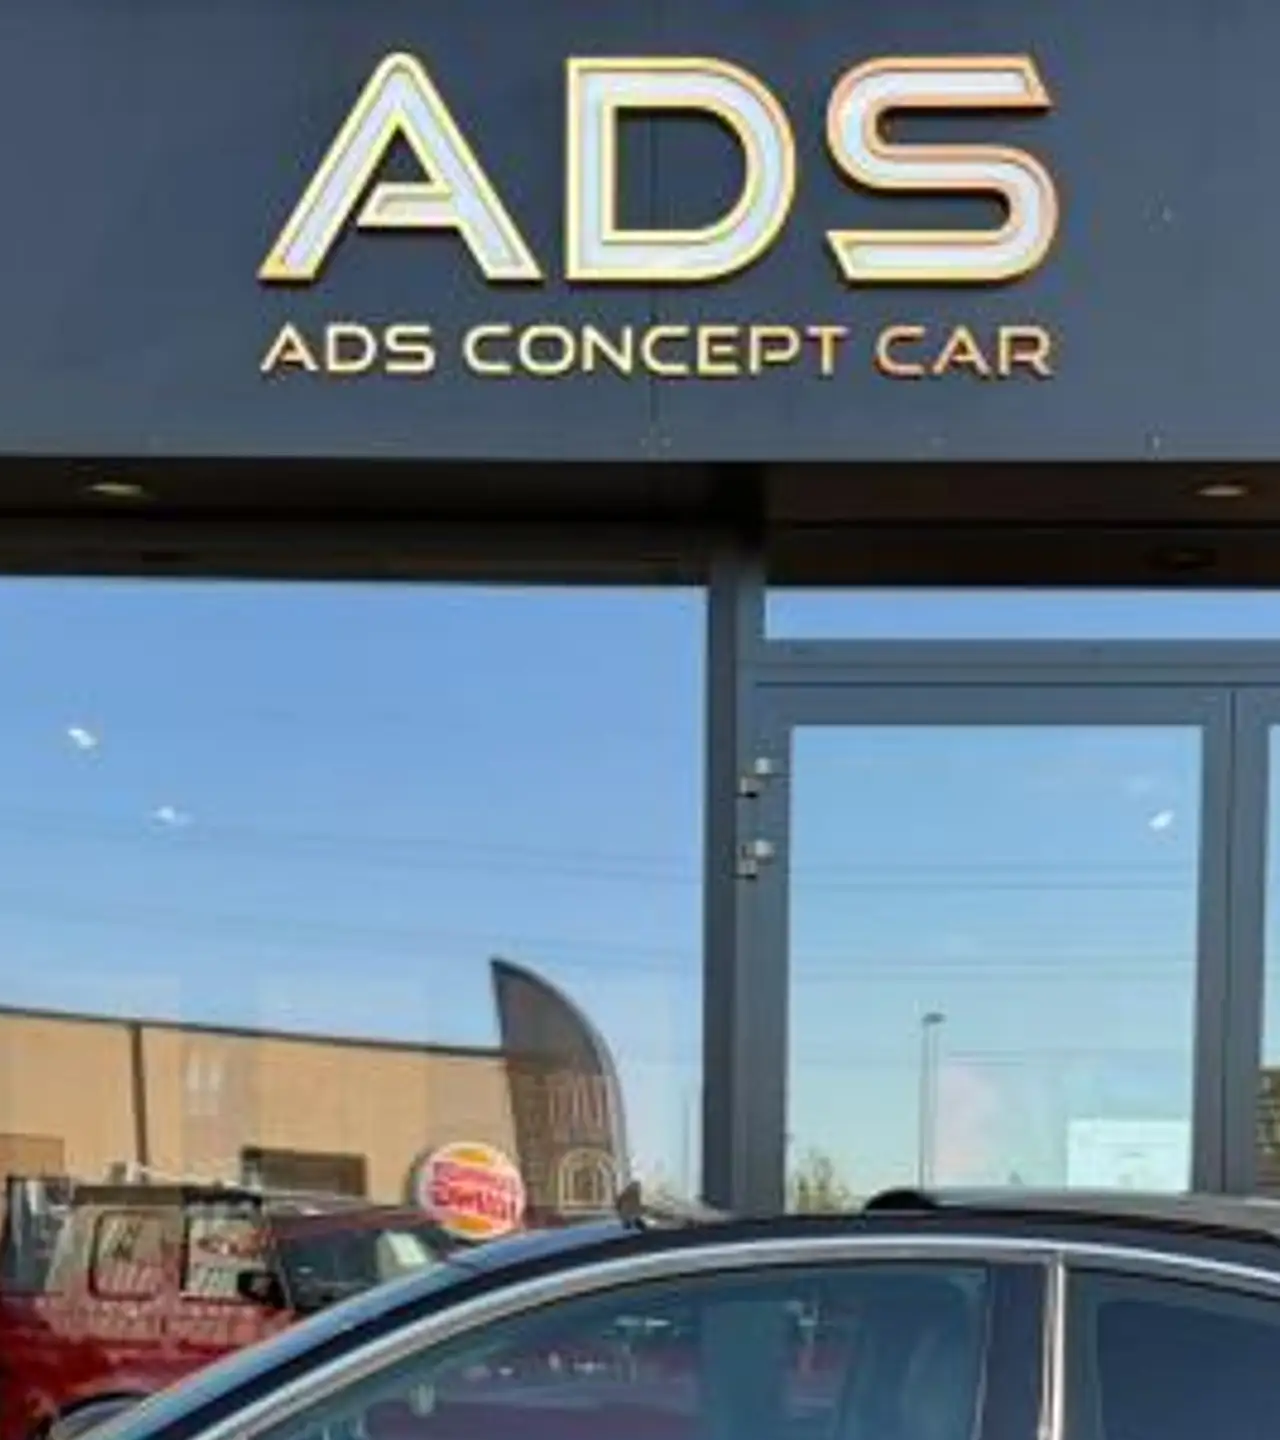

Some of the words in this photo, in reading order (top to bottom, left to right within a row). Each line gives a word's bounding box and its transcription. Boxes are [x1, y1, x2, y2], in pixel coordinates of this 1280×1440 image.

[257, 51, 1061, 283] ADS
[260, 323, 436, 374] ADS
[462, 323, 848, 375] CONCEPT
[874, 324, 1053, 376] CAR
